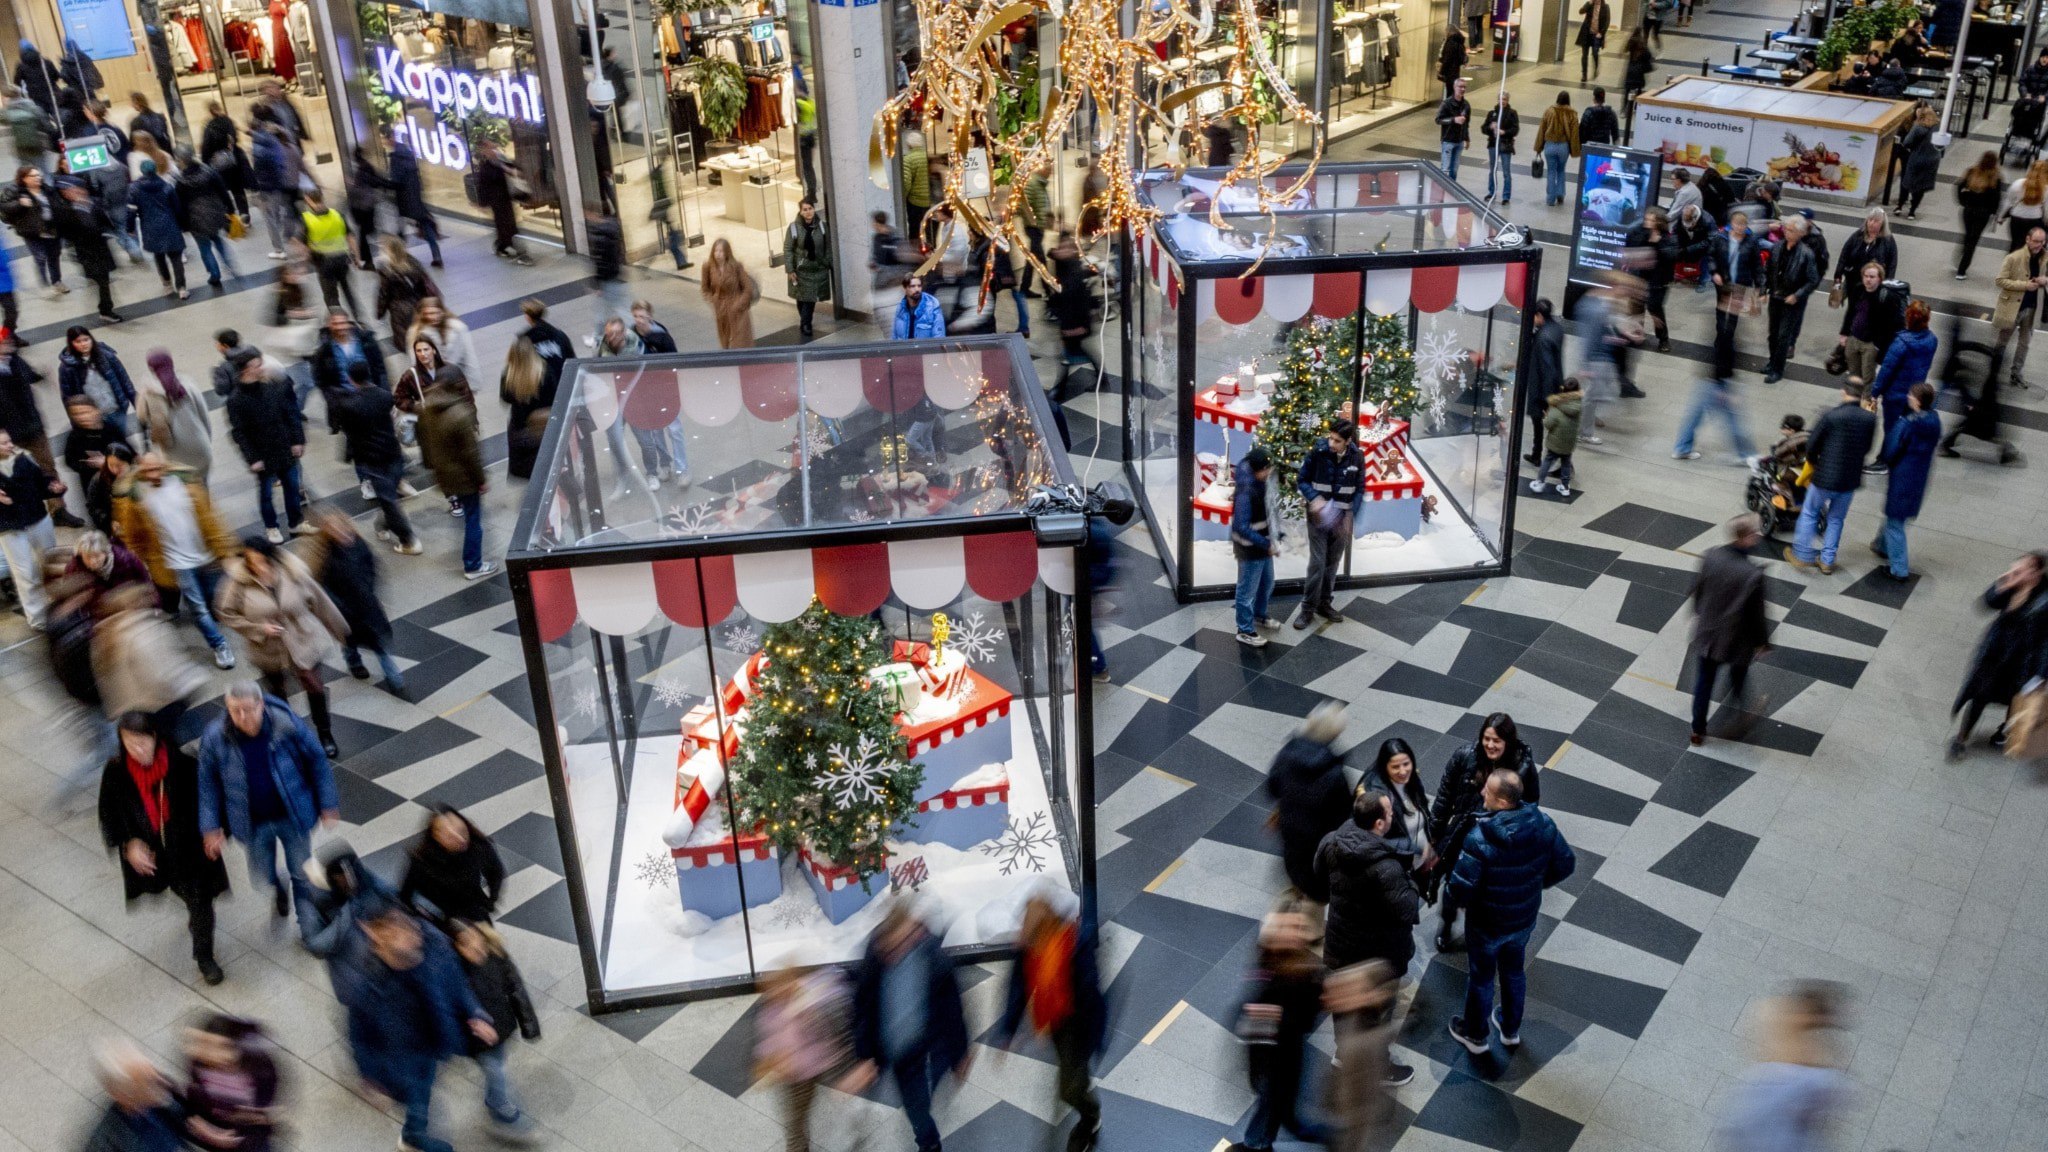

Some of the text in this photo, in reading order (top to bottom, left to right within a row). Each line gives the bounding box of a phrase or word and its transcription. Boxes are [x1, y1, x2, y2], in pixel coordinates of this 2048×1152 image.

[377, 46, 542, 122] Kappahl
[393, 115, 467, 170] club
[1644, 112, 1744, 133] Juice & Smoothies
